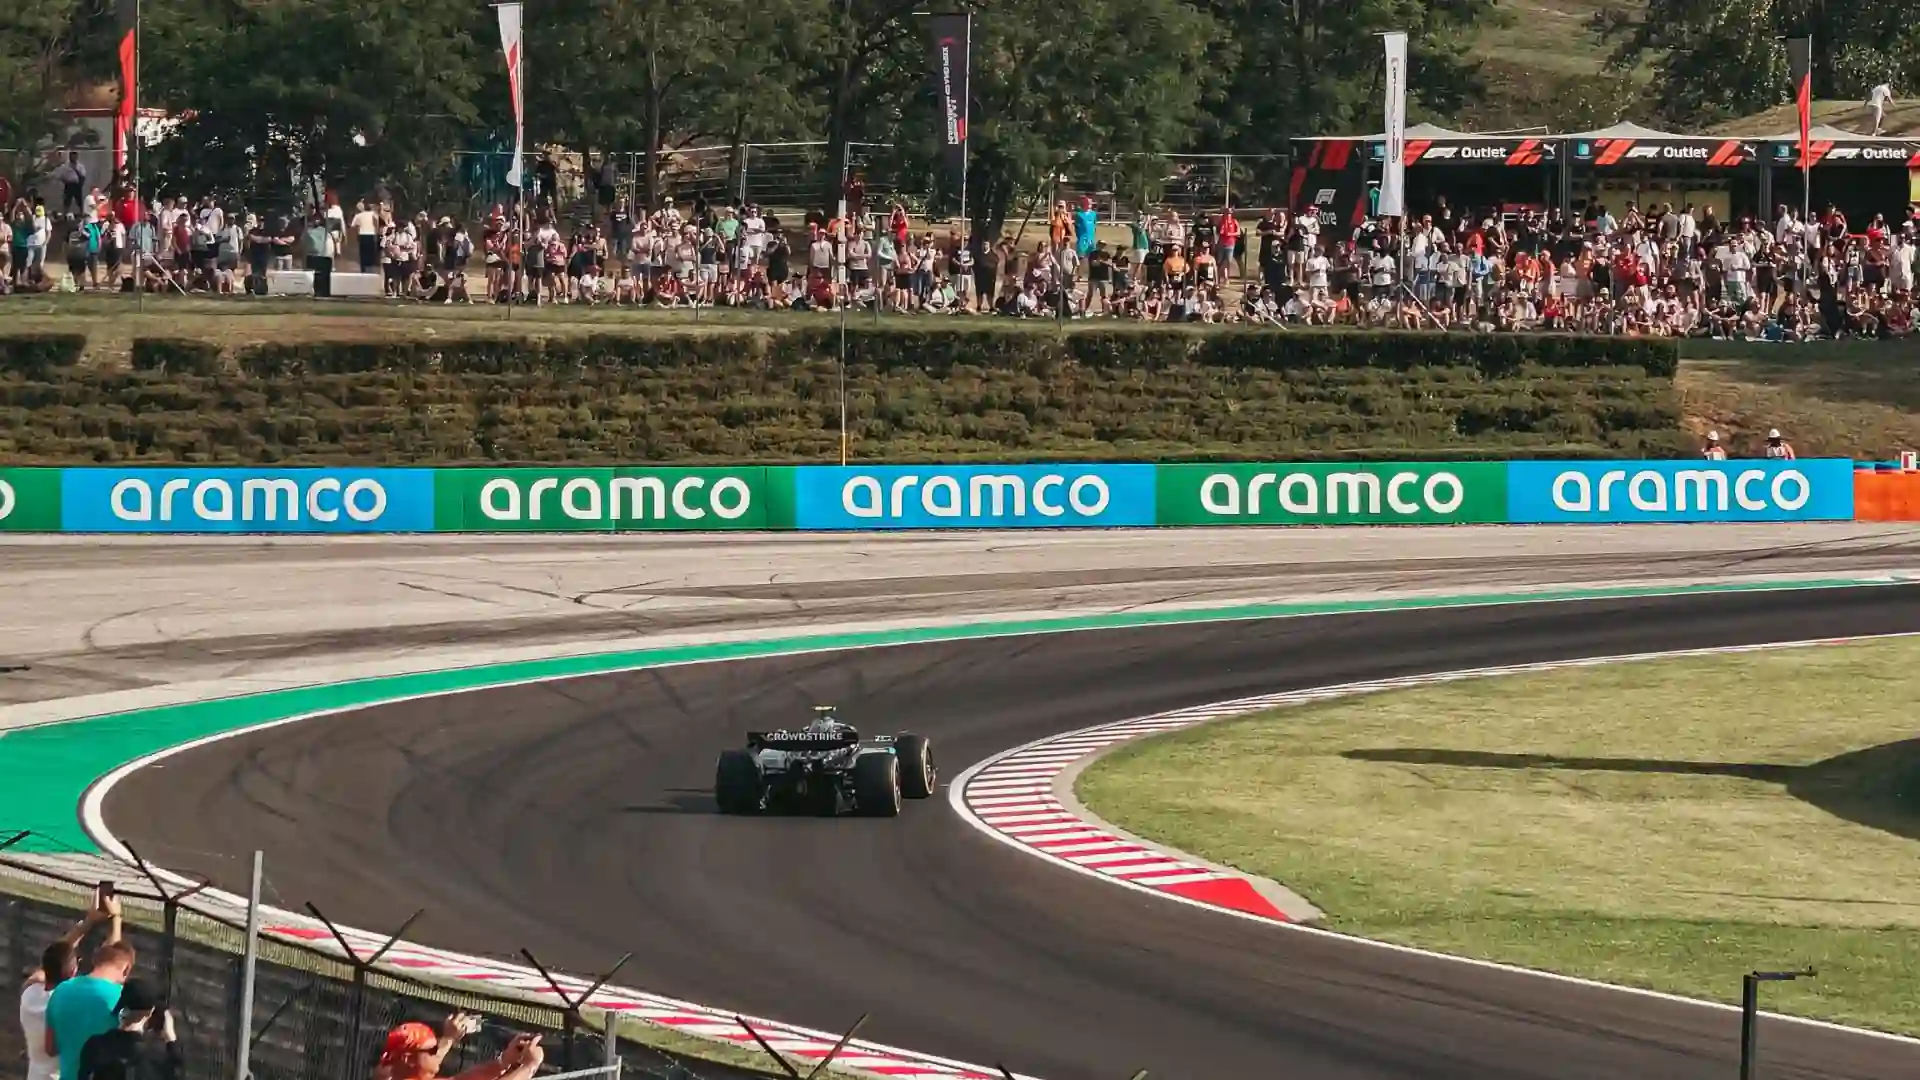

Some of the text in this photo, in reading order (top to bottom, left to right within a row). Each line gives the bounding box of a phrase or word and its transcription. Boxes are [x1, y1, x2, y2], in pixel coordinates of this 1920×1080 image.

[1461, 147, 1507, 158] Outlet
[1664, 147, 1709, 158] Outlet
[1862, 147, 1908, 159] Outlet
[1318, 210, 1337, 226] tore
[111, 479, 387, 521] aramco
[481, 477, 750, 520] aramco
[843, 475, 1110, 518] aramco
[1201, 472, 1464, 515] aramco
[1553, 470, 1810, 511] aramco
[766, 731, 843, 741] CROWDSTRIKE
